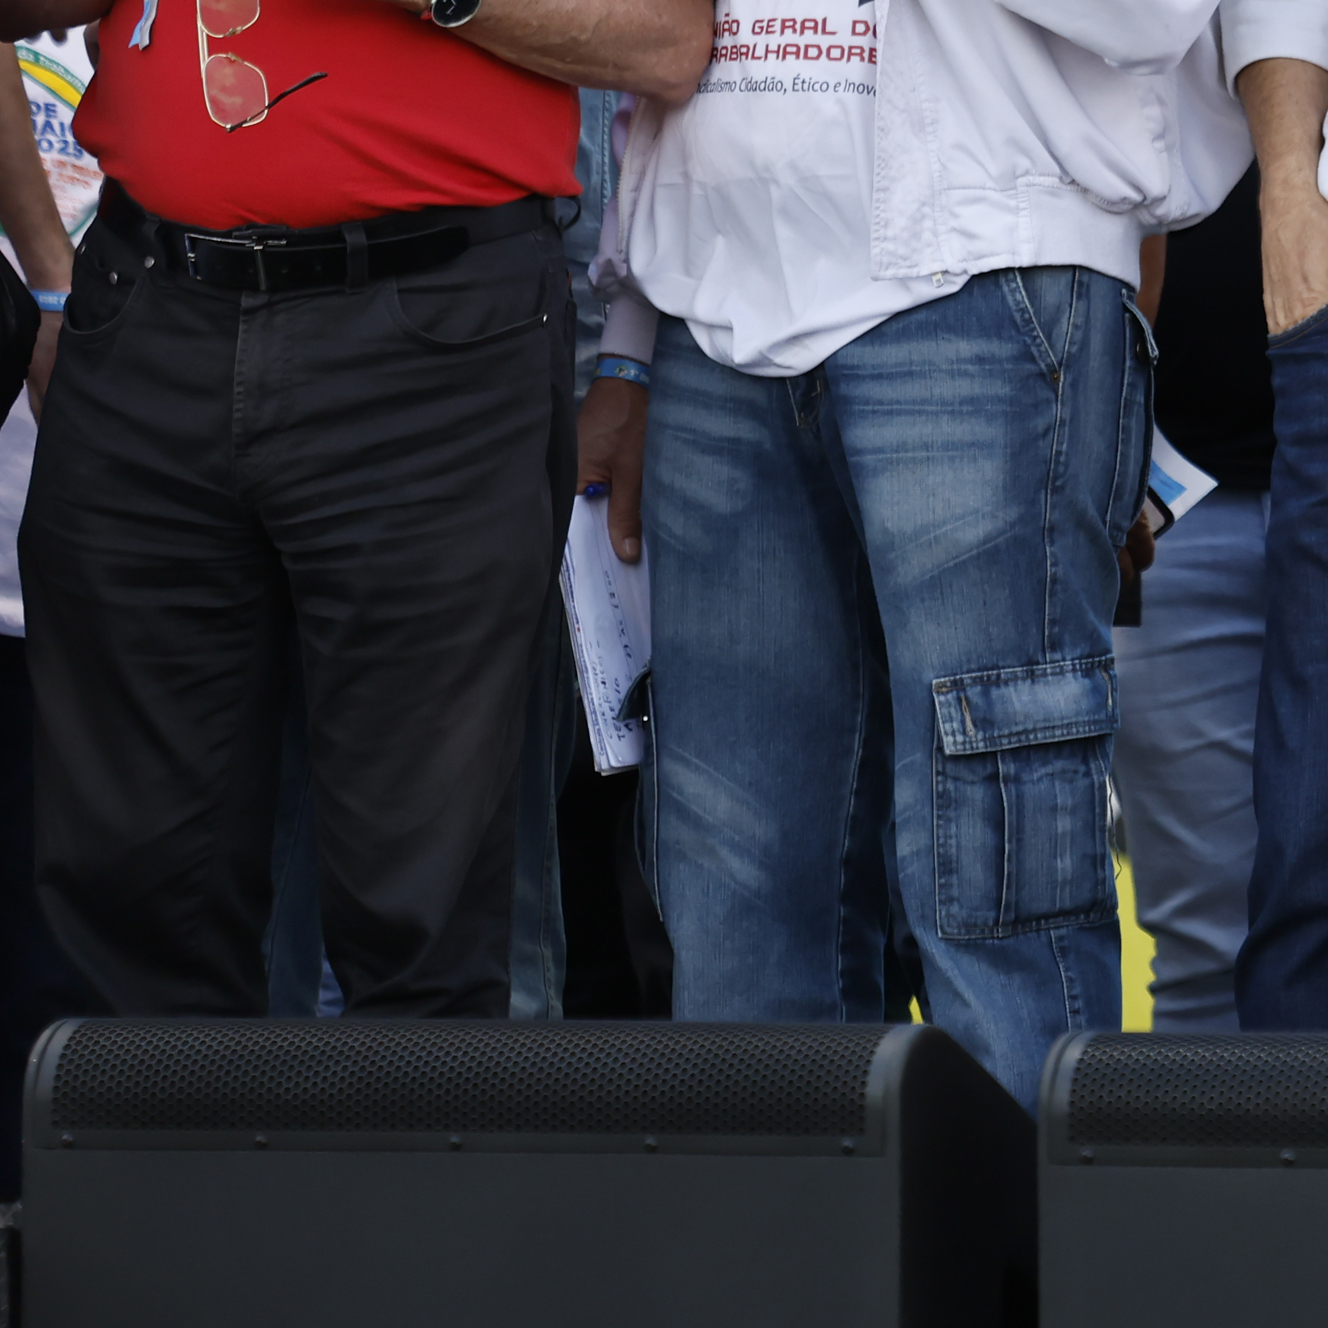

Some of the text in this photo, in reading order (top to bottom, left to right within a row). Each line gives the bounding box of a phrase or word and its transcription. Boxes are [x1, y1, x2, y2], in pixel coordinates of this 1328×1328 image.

[751, 17, 838, 38] GERAL
[738, 76, 788, 96] Cidadão,
[791, 73, 830, 93] Ético
[833, 81, 842, 93] e
[37, 137, 84, 160] 025
